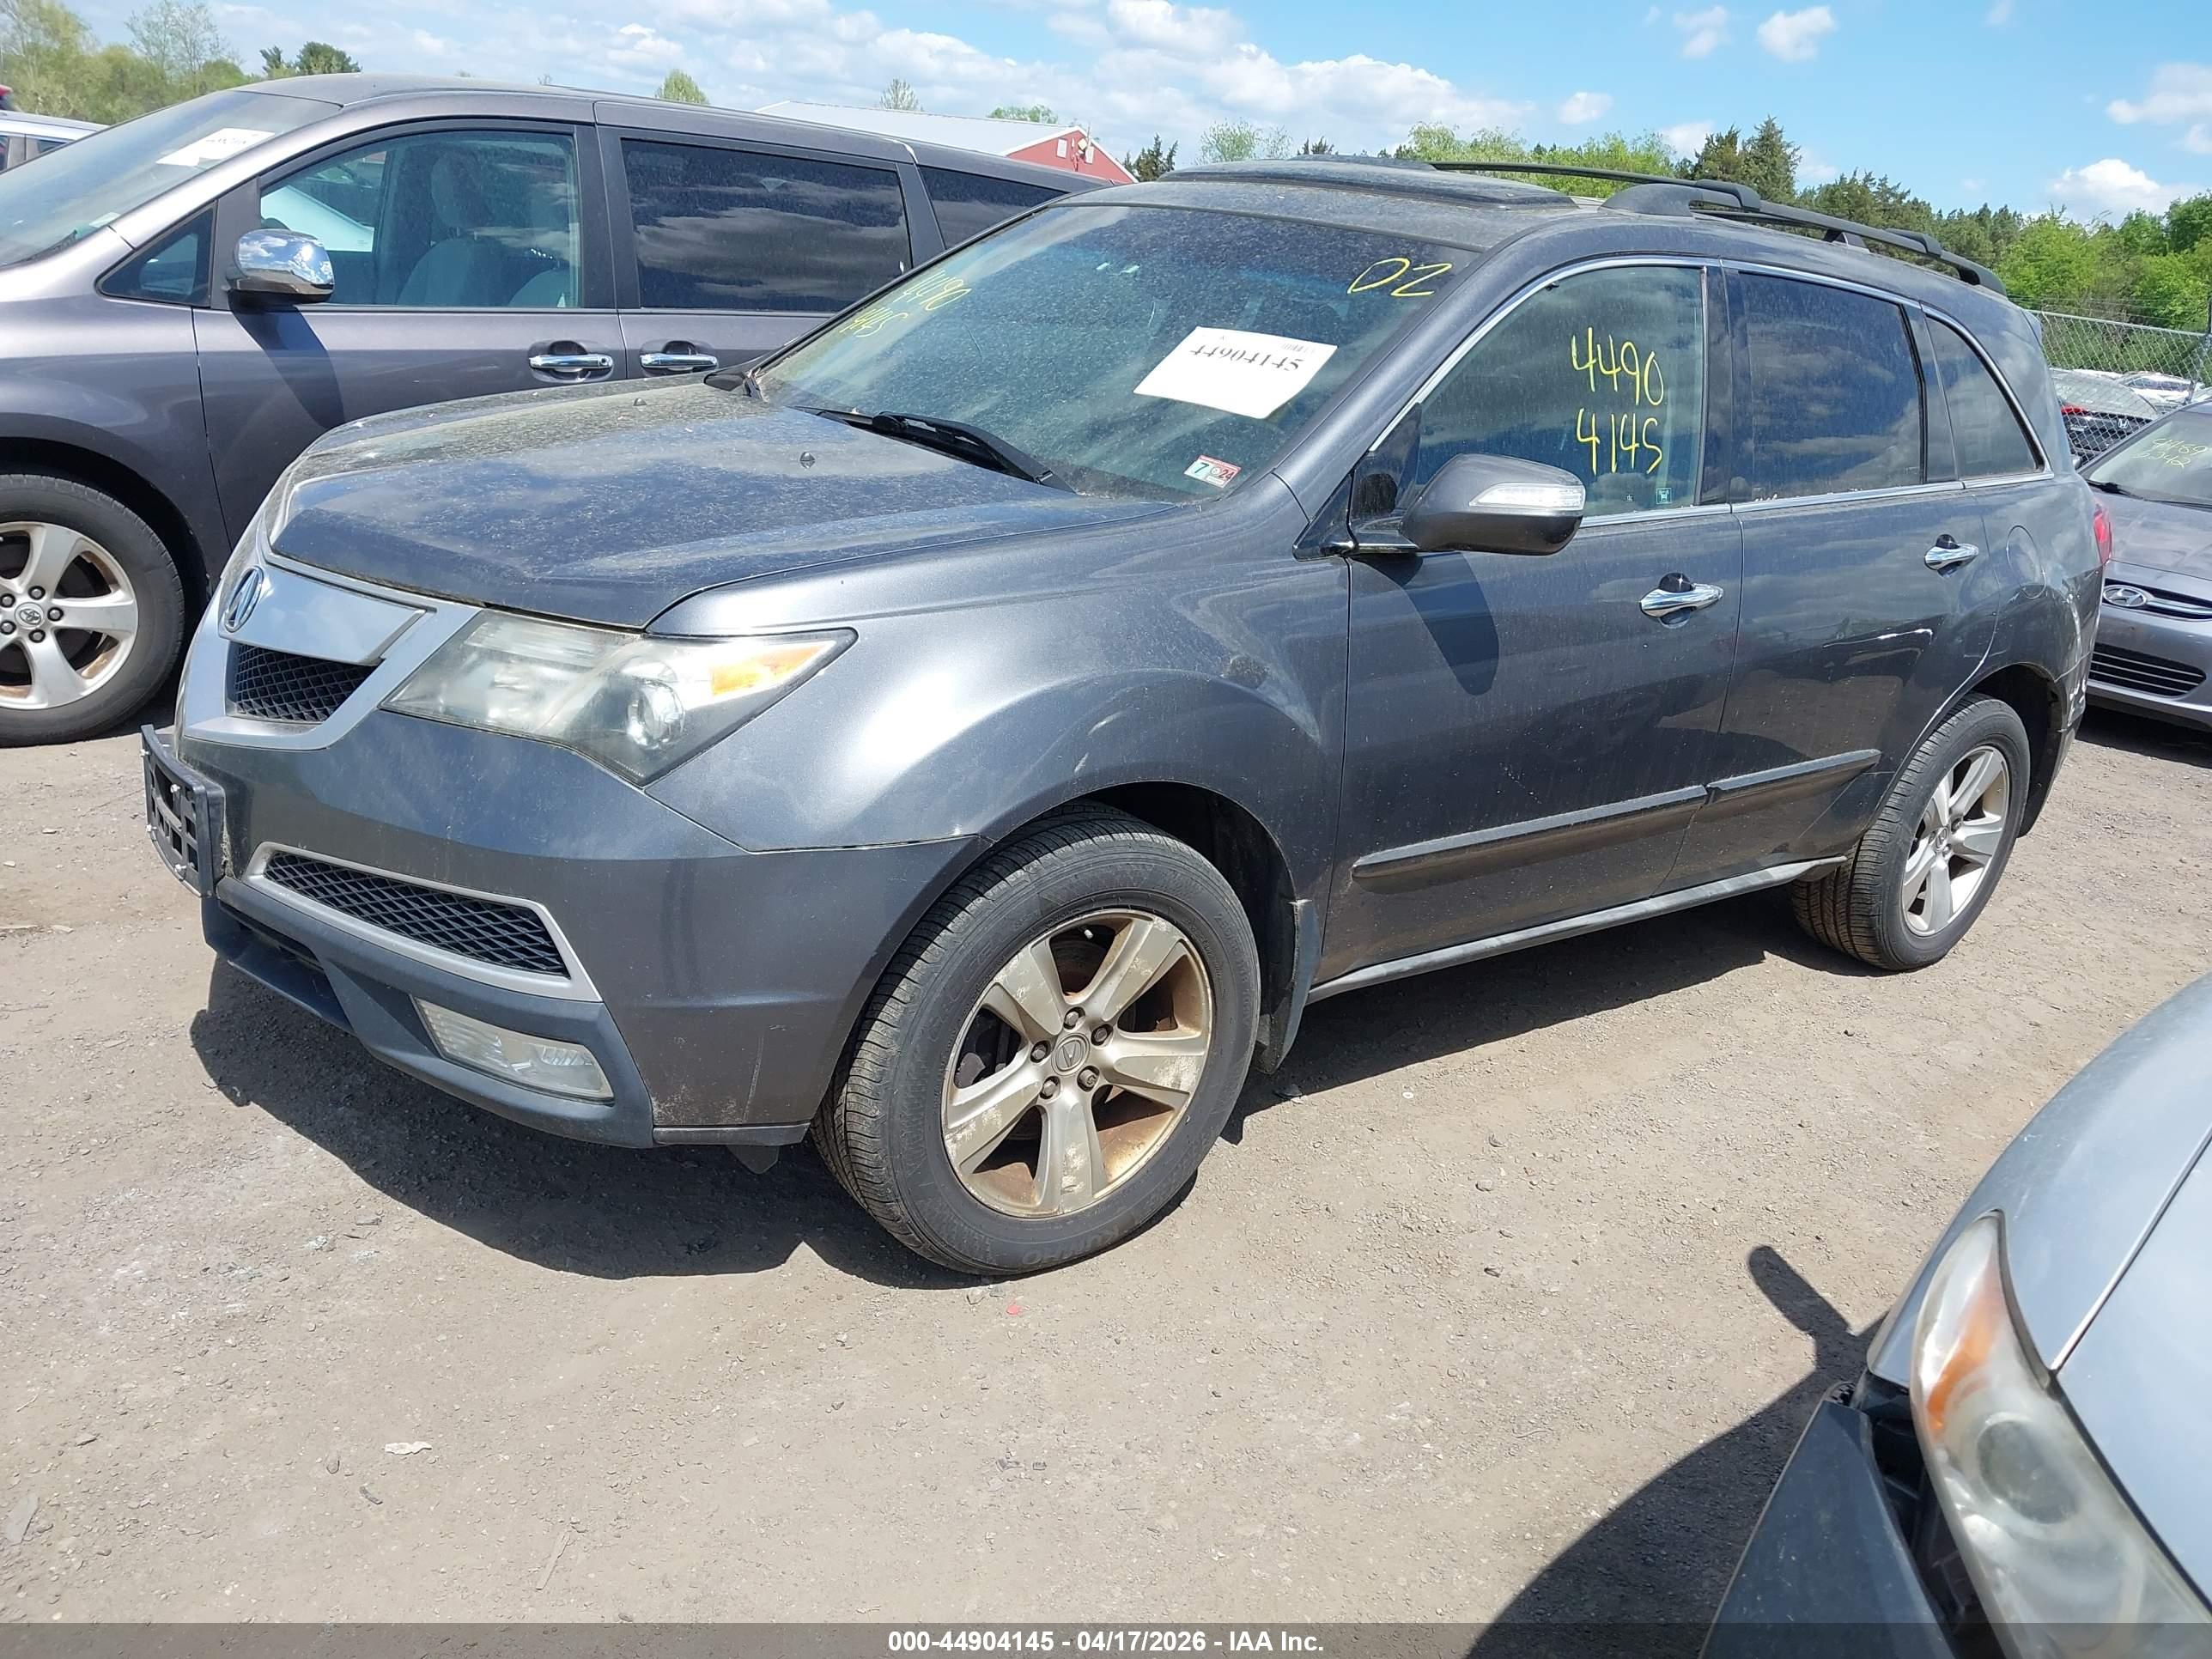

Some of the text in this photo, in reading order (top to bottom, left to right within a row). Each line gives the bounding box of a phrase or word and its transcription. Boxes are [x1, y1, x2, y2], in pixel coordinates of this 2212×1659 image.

[1188, 343, 1305, 372] 44904145
[1571, 326, 1665, 407] 4490
[1576, 407, 1663, 477] 4145
[1194, 462, 1210, 474] 7
[1218, 469, 1236, 480] 24
